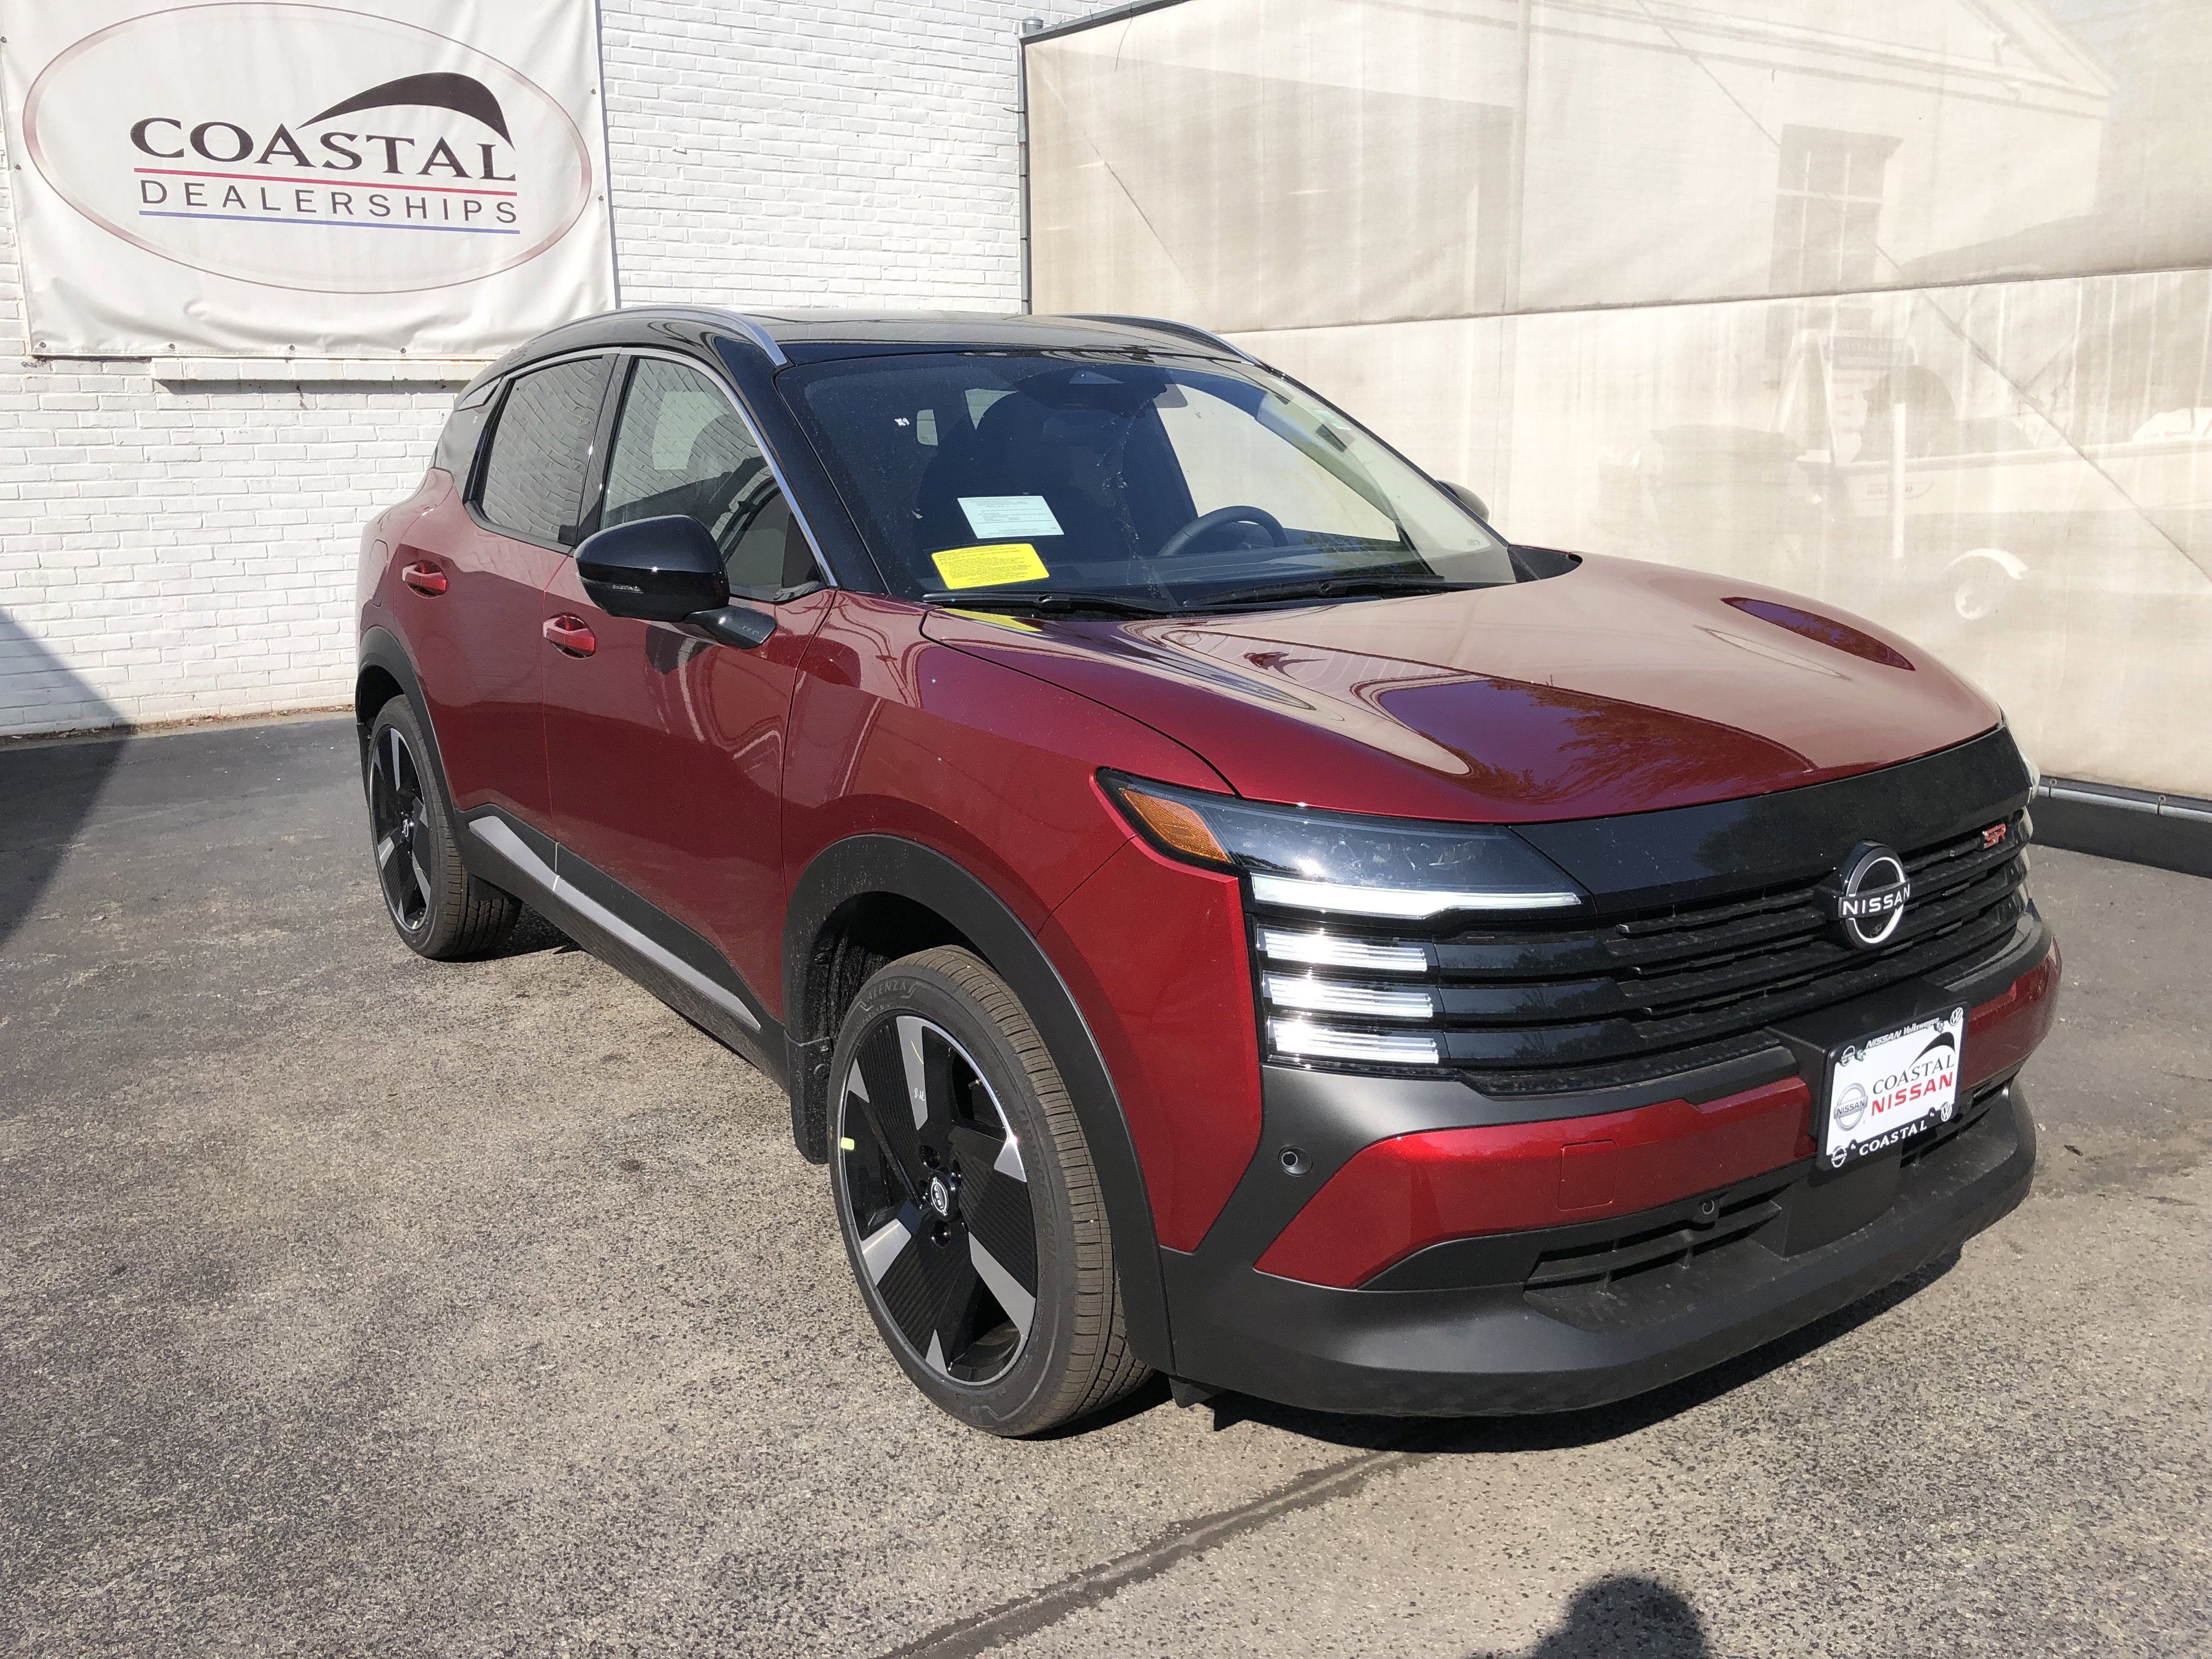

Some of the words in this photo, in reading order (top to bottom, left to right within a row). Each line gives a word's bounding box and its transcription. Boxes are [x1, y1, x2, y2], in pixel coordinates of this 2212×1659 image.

[130, 117, 516, 182] COASTAL
[140, 179, 517, 224] DEALERSHIPS
[1842, 884, 1910, 916] NISSAN
[867, 980, 906, 1002] ALENZA
[1865, 1030, 1902, 1048] NISSAN
[1873, 1054, 1955, 1094] COASTAL
[1836, 1099, 1865, 1115] NISSAN
[1871, 1071, 1953, 1116] NISSAN
[1859, 1120, 1927, 1155] COASTAL
